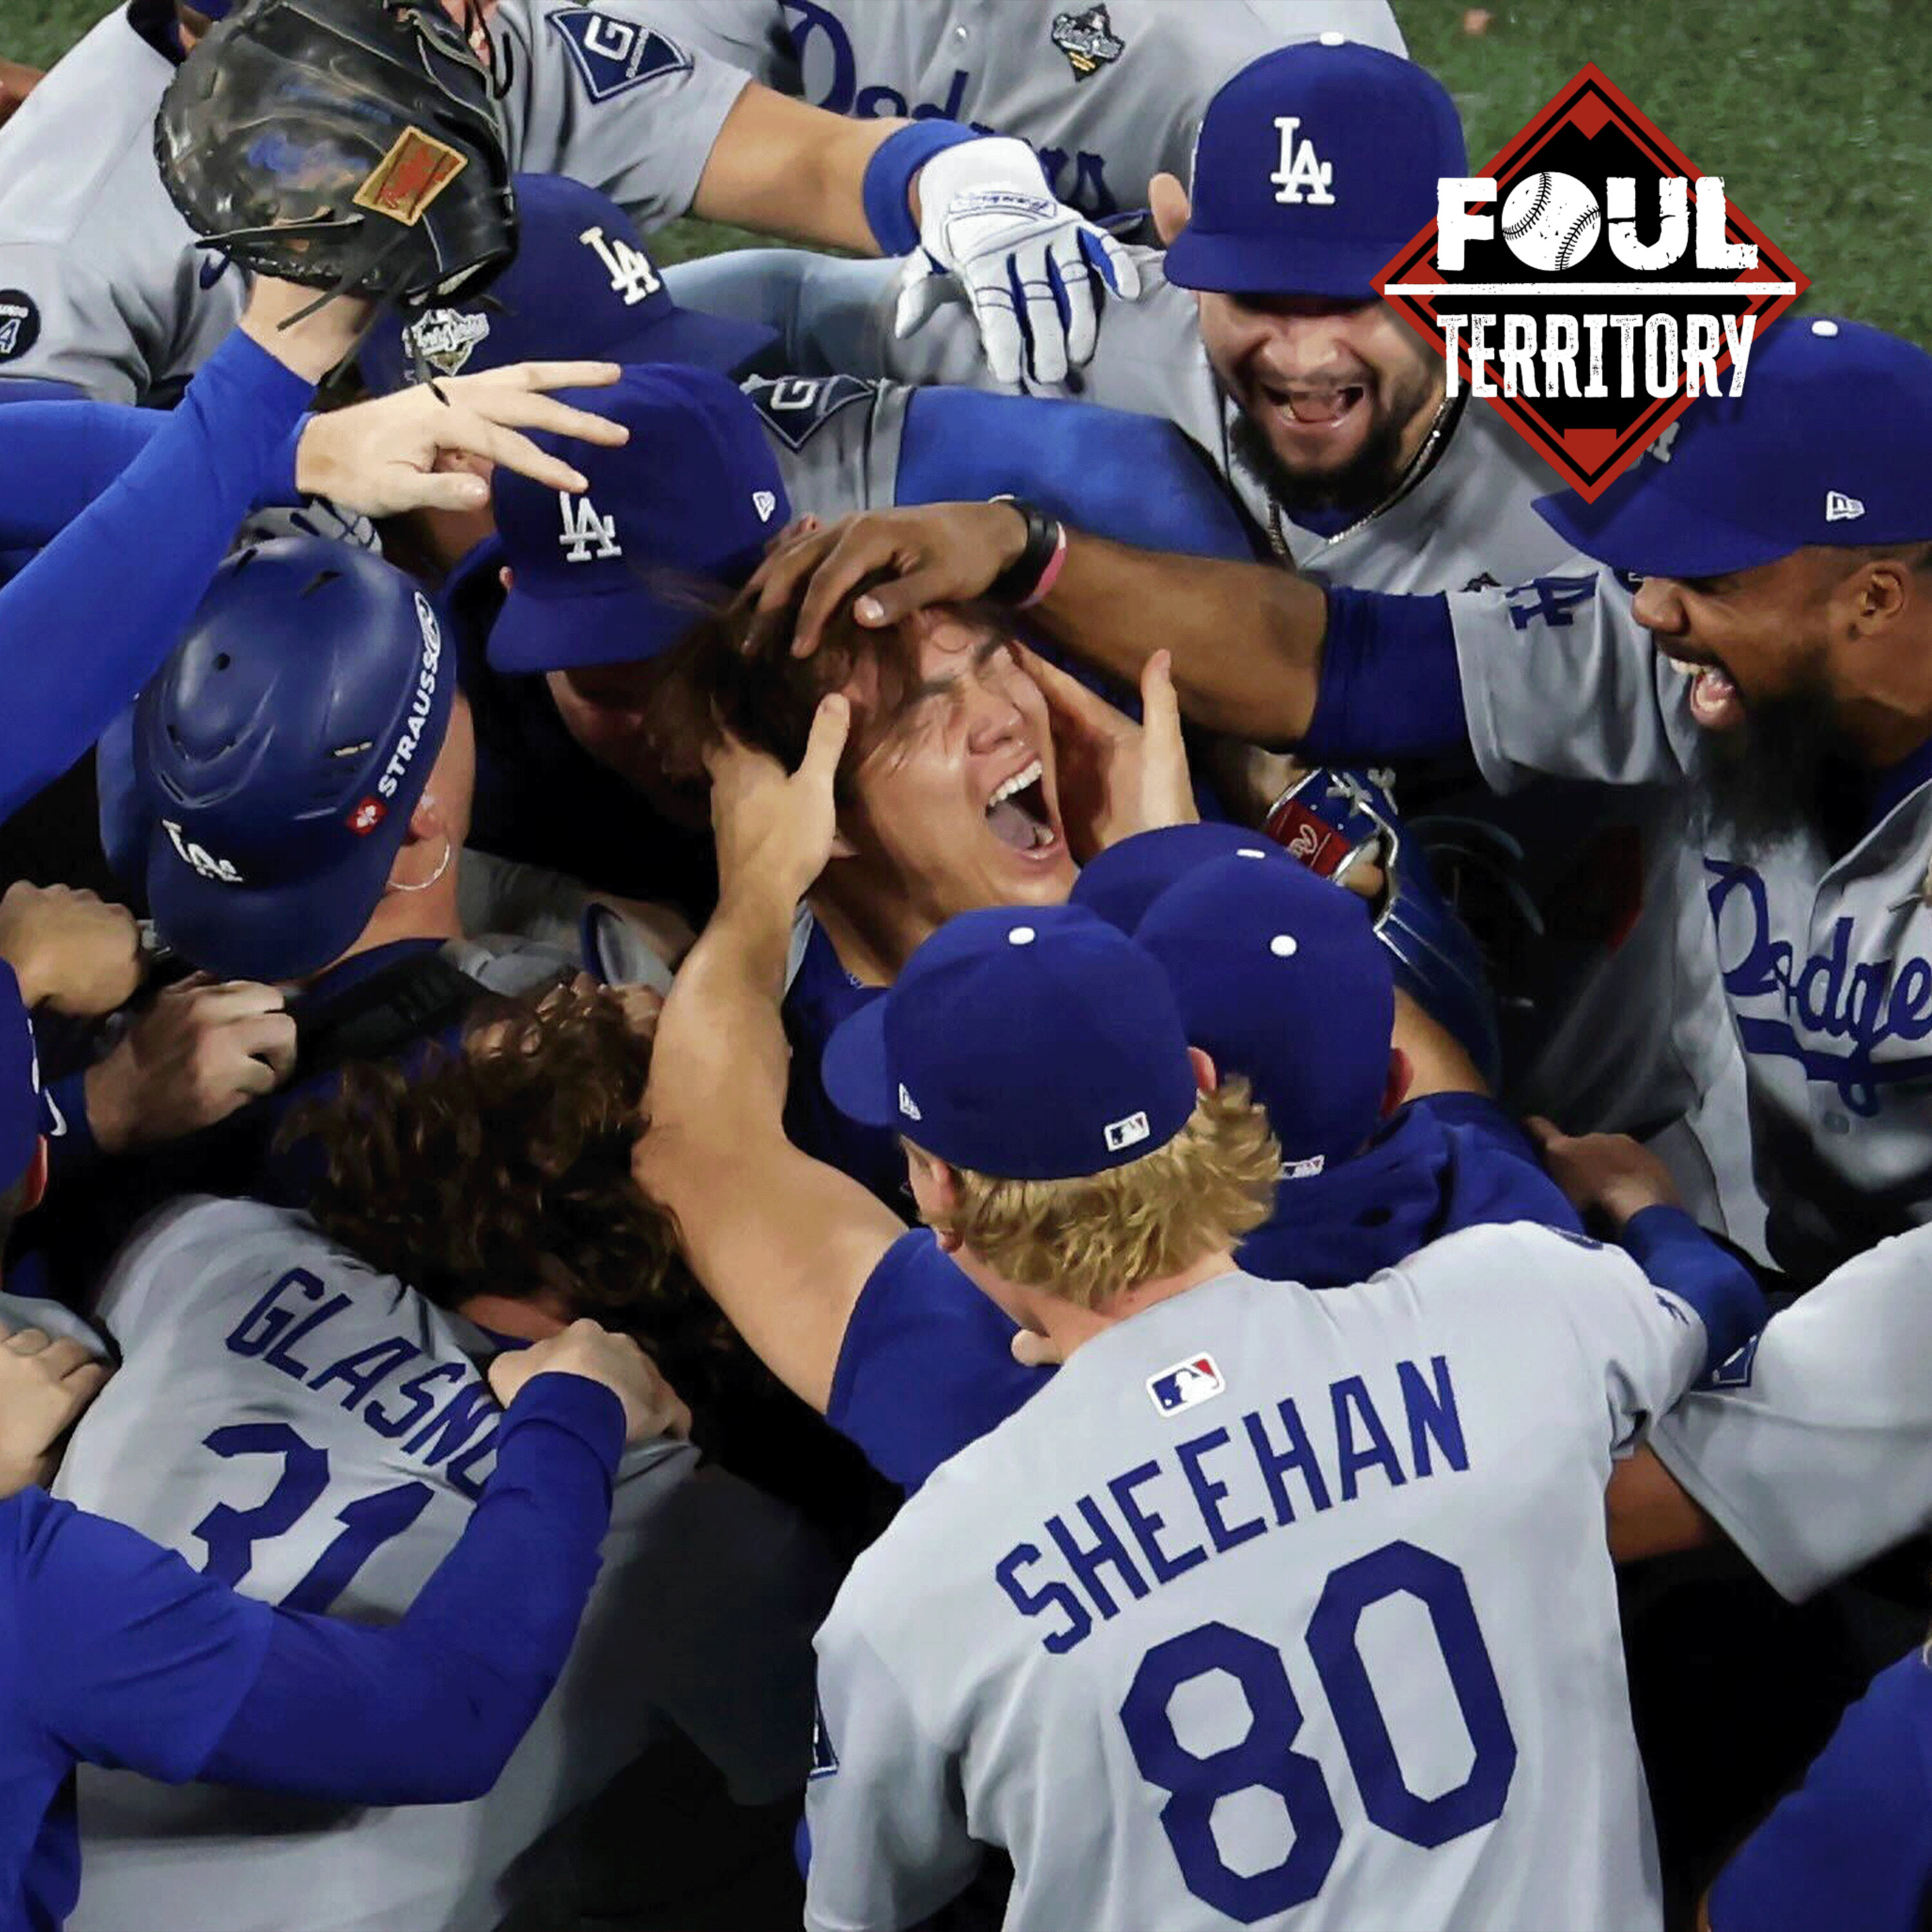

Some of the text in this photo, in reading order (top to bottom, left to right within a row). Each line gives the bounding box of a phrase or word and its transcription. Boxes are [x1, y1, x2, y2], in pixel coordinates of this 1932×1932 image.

[1271, 117, 1335, 205] LA
[580, 226, 660, 305] LA
[559, 489, 622, 562] LA
[378, 649, 440, 797] STRAUSS
[996, 1355, 1470, 1654] SHEEHAN
[1119, 1540, 1517, 1925] 80
